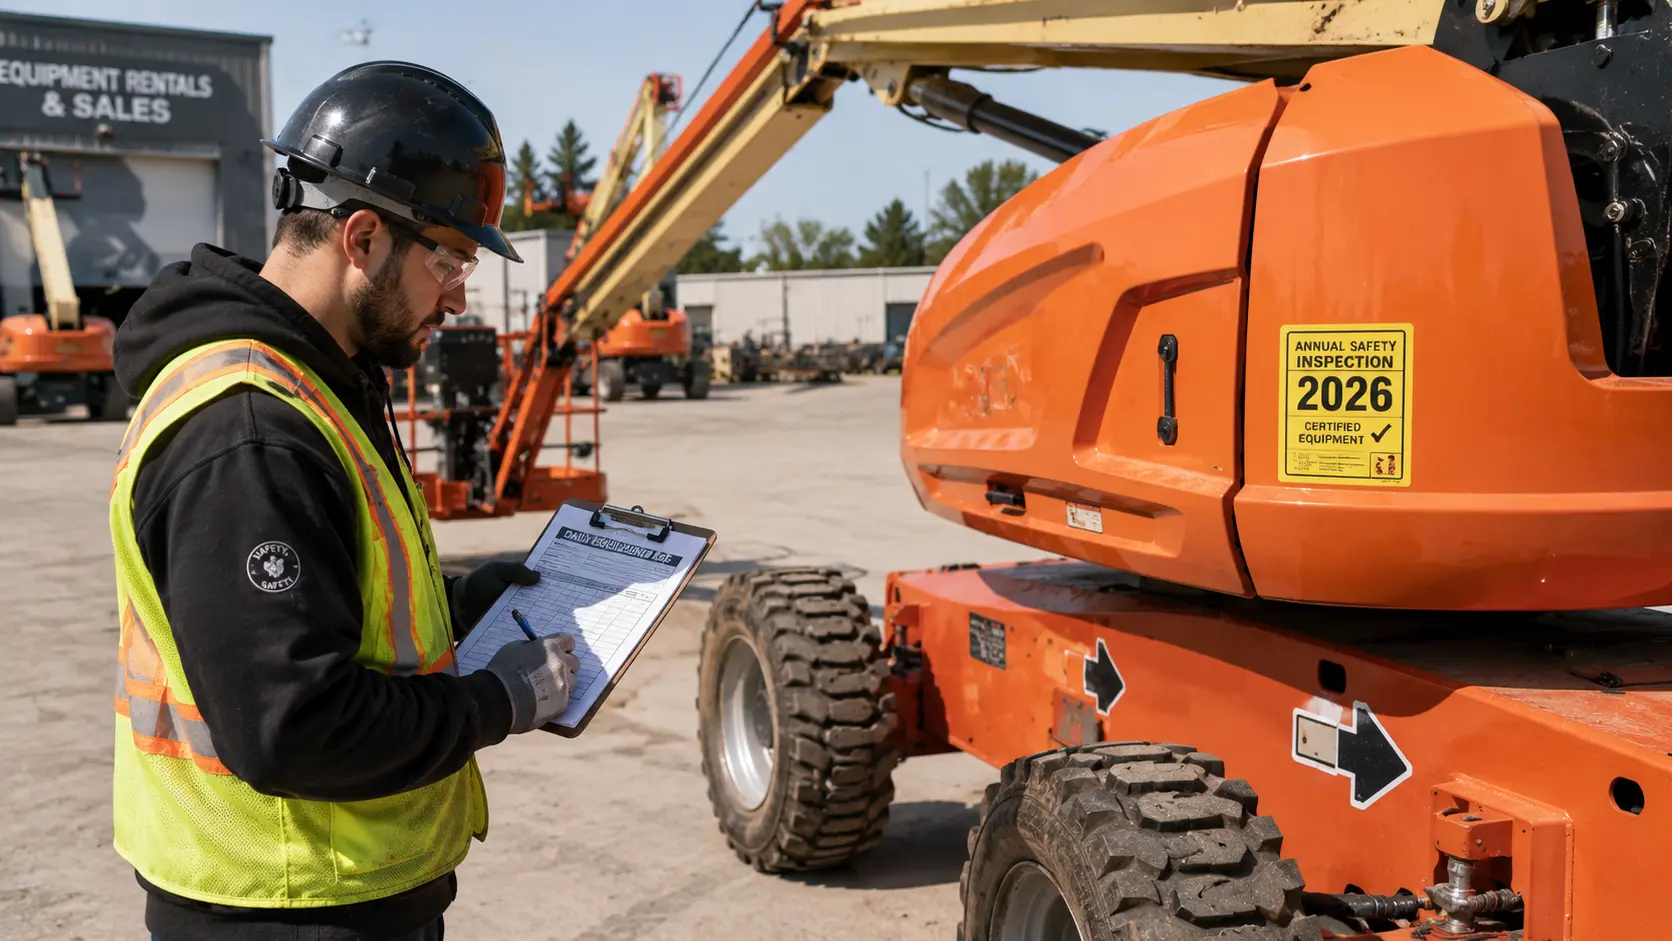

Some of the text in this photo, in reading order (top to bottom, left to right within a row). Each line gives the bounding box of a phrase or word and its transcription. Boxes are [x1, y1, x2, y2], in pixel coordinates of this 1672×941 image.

[0, 59, 213, 98] EQUIPMENT RENTALS
[41, 91, 171, 124] & SALES
[1295, 341, 1397, 351] ANNUAL SAFETY
[1296, 355, 1394, 368] INSPECTION
[1297, 375, 1393, 412] 2026
[1304, 422, 1361, 431] CERTIFIED
[1298, 434, 1364, 444] EQUIPMENT
